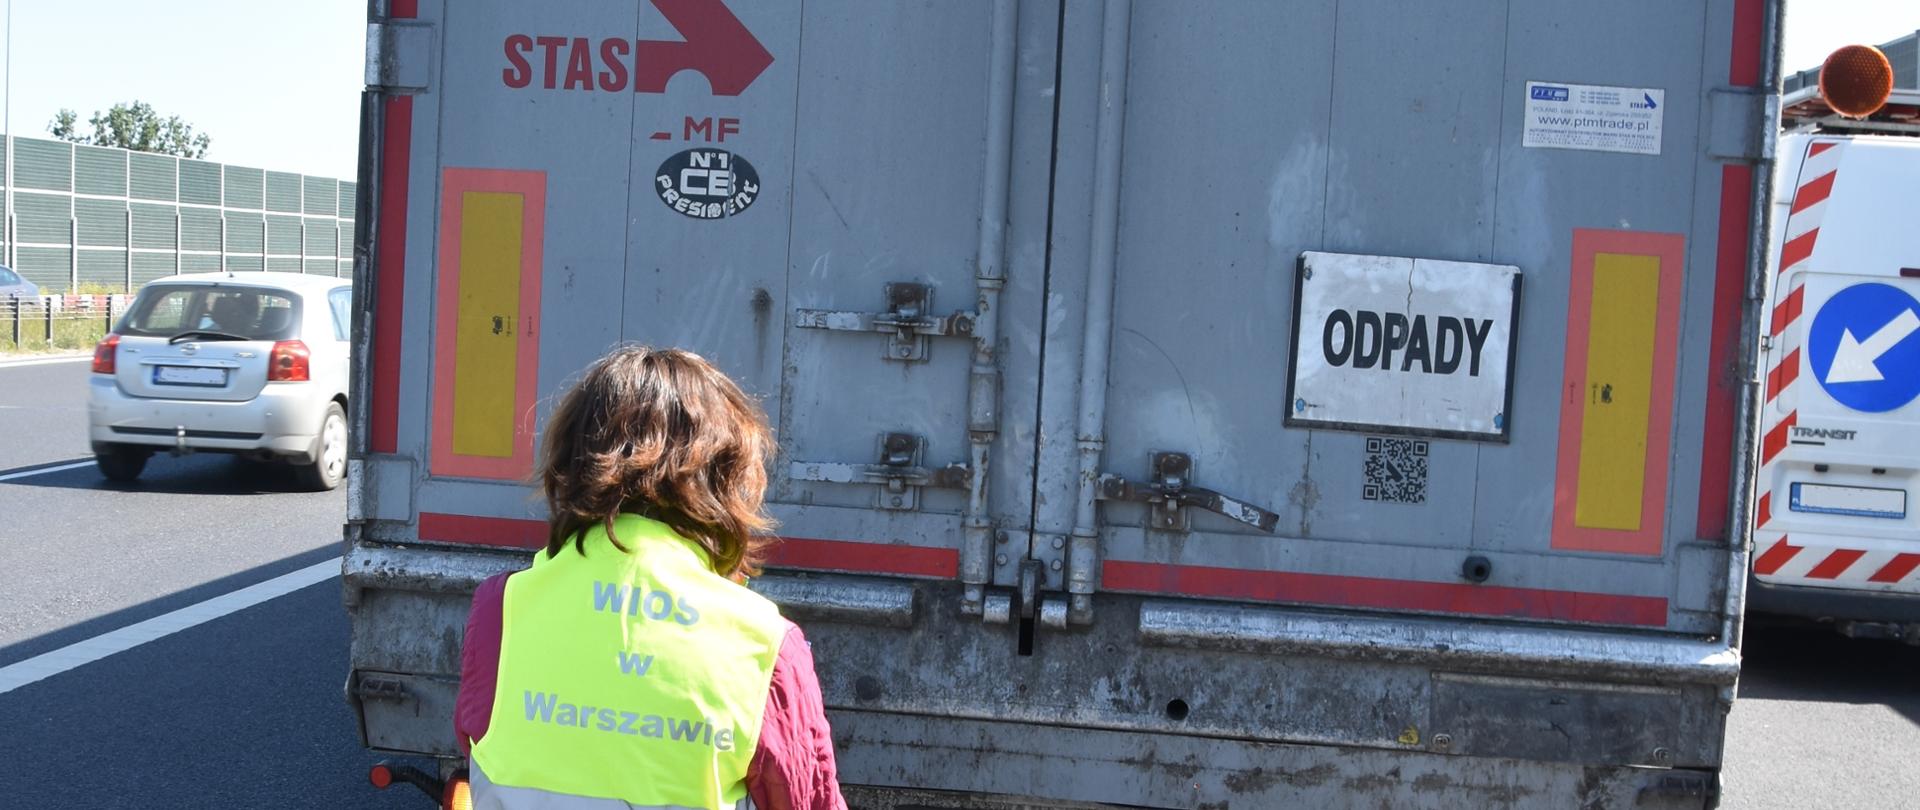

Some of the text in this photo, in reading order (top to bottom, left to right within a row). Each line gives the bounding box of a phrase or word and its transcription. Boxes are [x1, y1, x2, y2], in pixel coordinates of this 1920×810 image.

[502, 33, 630, 93] STAS
[683, 116, 740, 143] MF
[1538, 115, 1649, 132] www.ptmtrade.pl
[1322, 308, 1494, 377] ODPADY
[1792, 427, 1857, 440] TRANSIT
[523, 690, 735, 750] Warszawie
